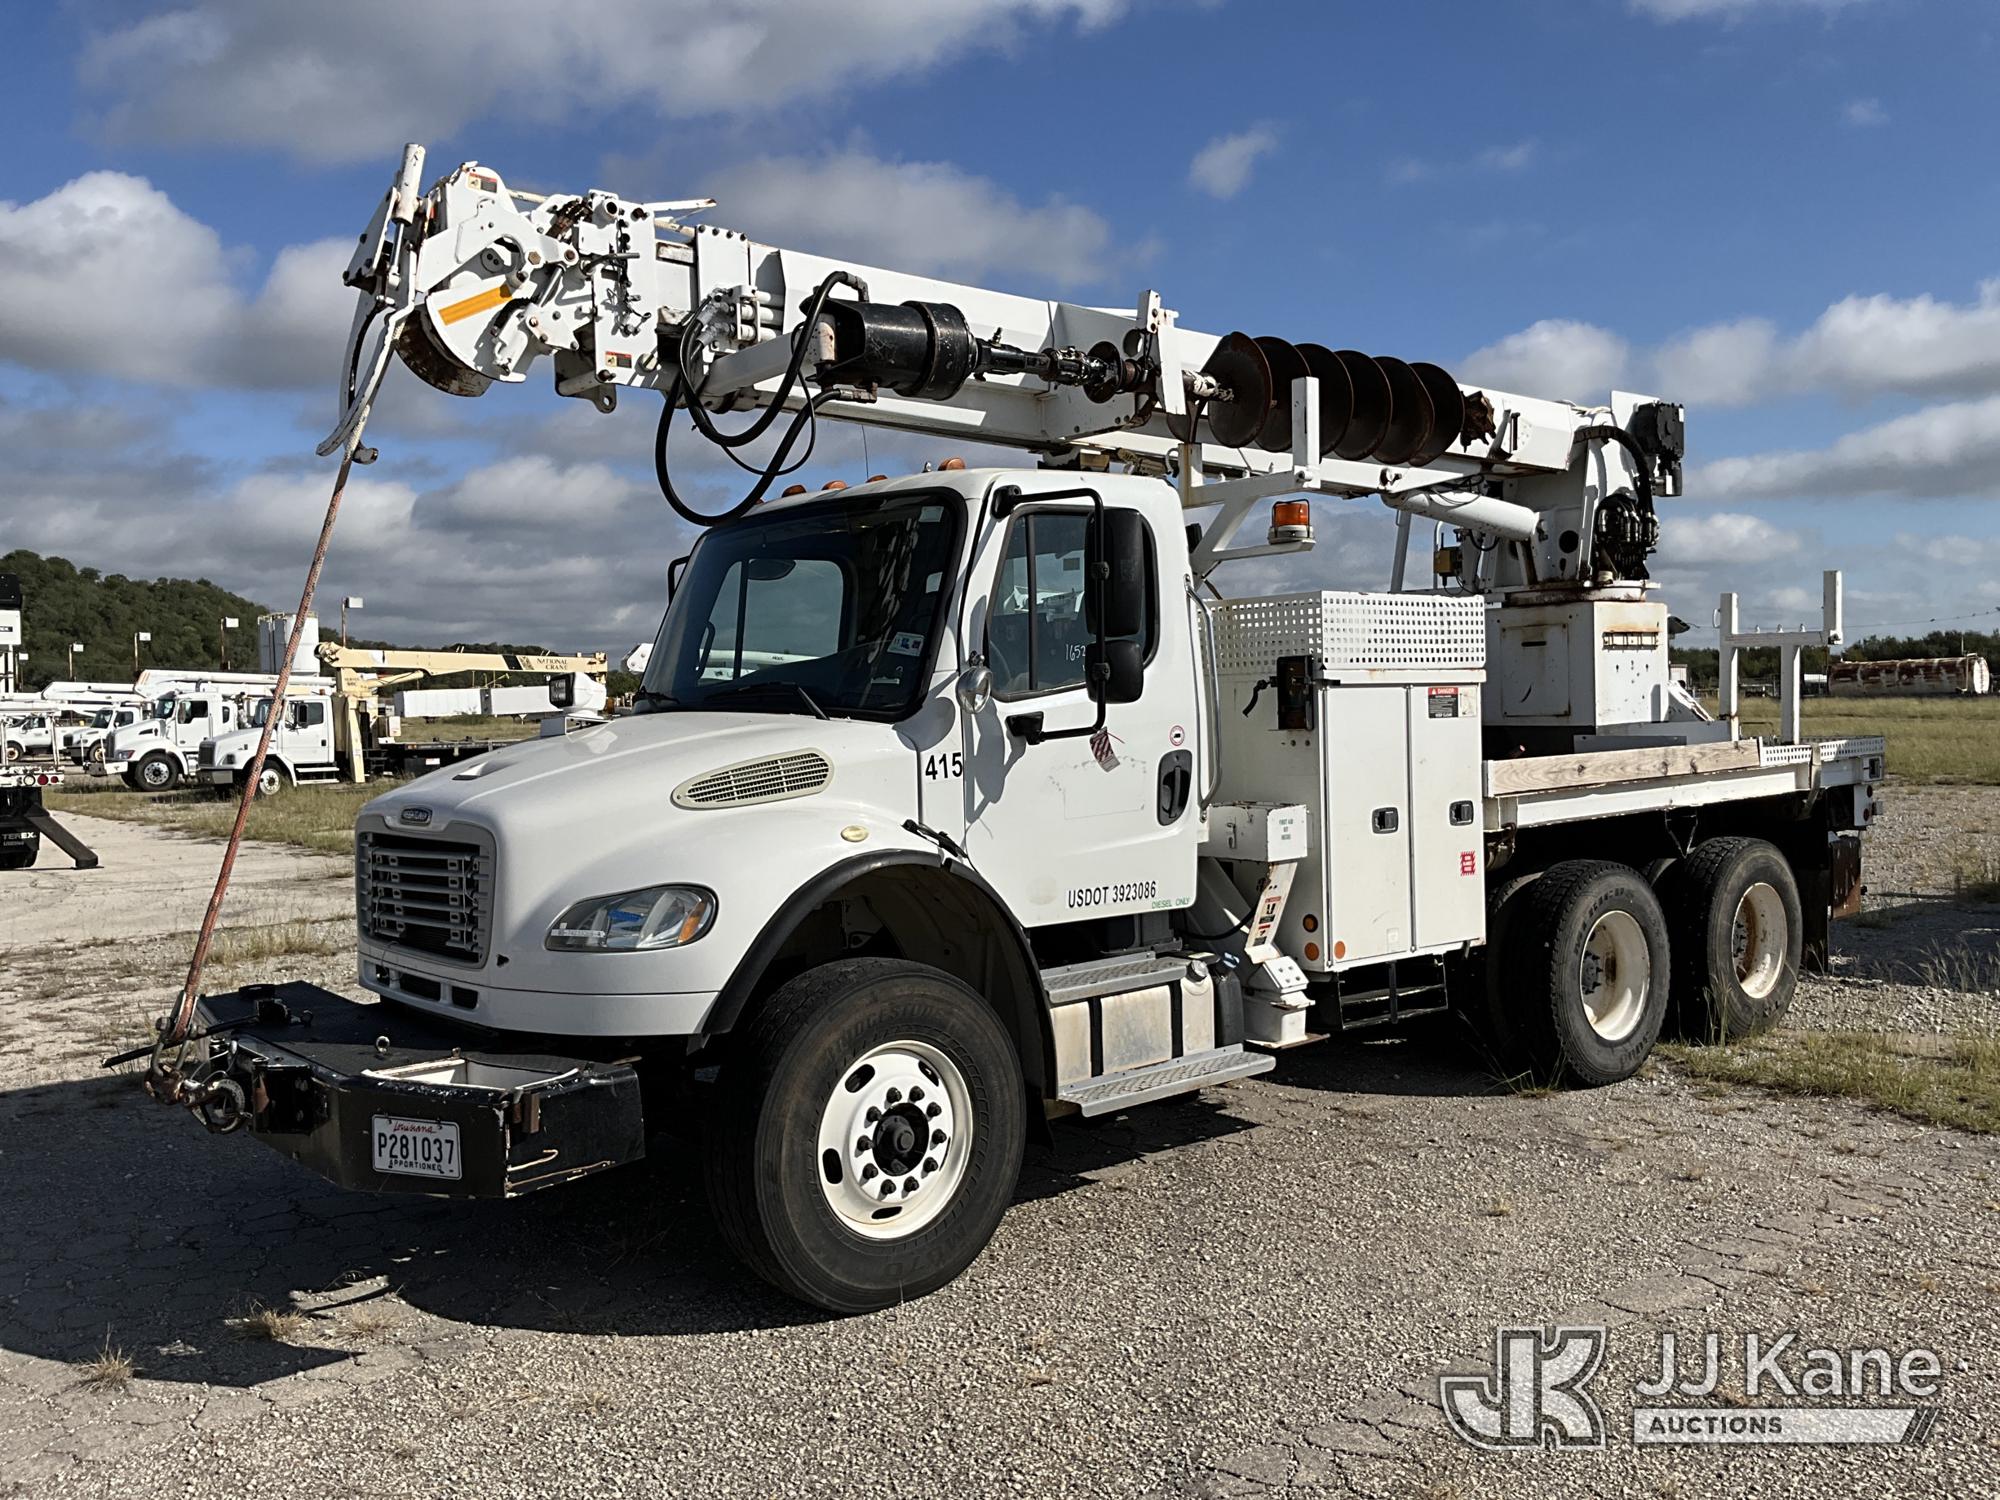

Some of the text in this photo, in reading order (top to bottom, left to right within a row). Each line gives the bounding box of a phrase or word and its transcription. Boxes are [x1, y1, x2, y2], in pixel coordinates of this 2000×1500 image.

[536, 657, 568, 665] NATIONAL
[925, 751, 963, 780] 415
[2, 831, 35, 840] TEREX
[1068, 880, 1157, 908] USDOT 3923086
[1151, 897, 1190, 909] DIESEL ONLY
[378, 1132, 455, 1165] P281037
